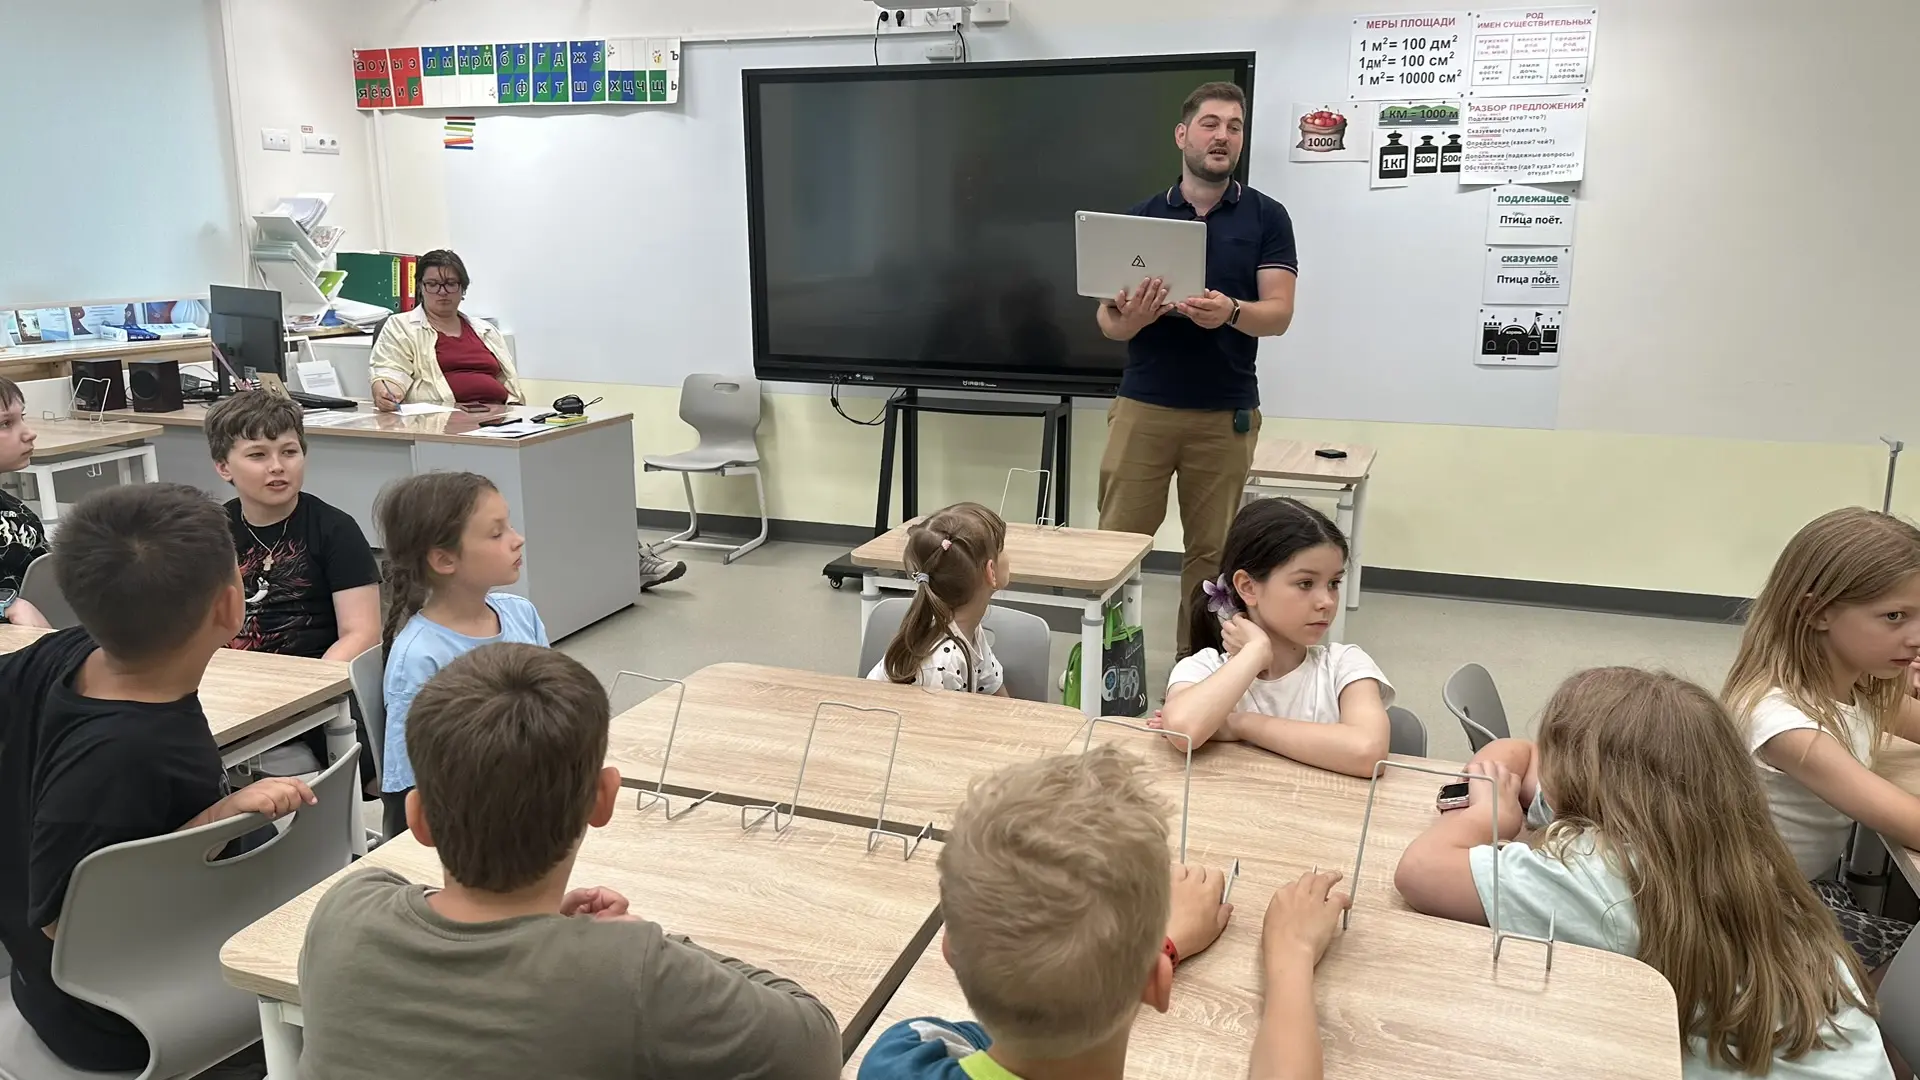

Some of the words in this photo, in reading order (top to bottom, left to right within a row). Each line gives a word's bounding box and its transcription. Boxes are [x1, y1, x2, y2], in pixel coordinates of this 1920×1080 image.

[1366, 20, 1398, 29] МЕРЫ
[1400, 18, 1456, 28] ПЛОЩАДИ
[1503, 19, 1592, 28] СУЩЕСТВИТЕЛЬНЫХ
[1360, 40, 1366, 51] 1
[1402, 38, 1426, 50] 100
[1401, 55, 1424, 67] 100
[1358, 74, 1364, 85] 1
[1399, 72, 1435, 84] 10000
[1509, 102, 1584, 111] ПРЕДЛОЖЕНИЯ
[1420, 109, 1446, 118] 1000
[1308, 138, 1338, 147] 1000г
[1416, 155, 1435, 163] 500г
[1498, 195, 1569, 204] подлежащее
[1500, 215, 1532, 225] Птица
[1535, 215, 1562, 224] поёт.
[1501, 255, 1558, 264] сказуемое
[1497, 275, 1529, 285] Птица
[1531, 274, 1559, 284] поёт.
